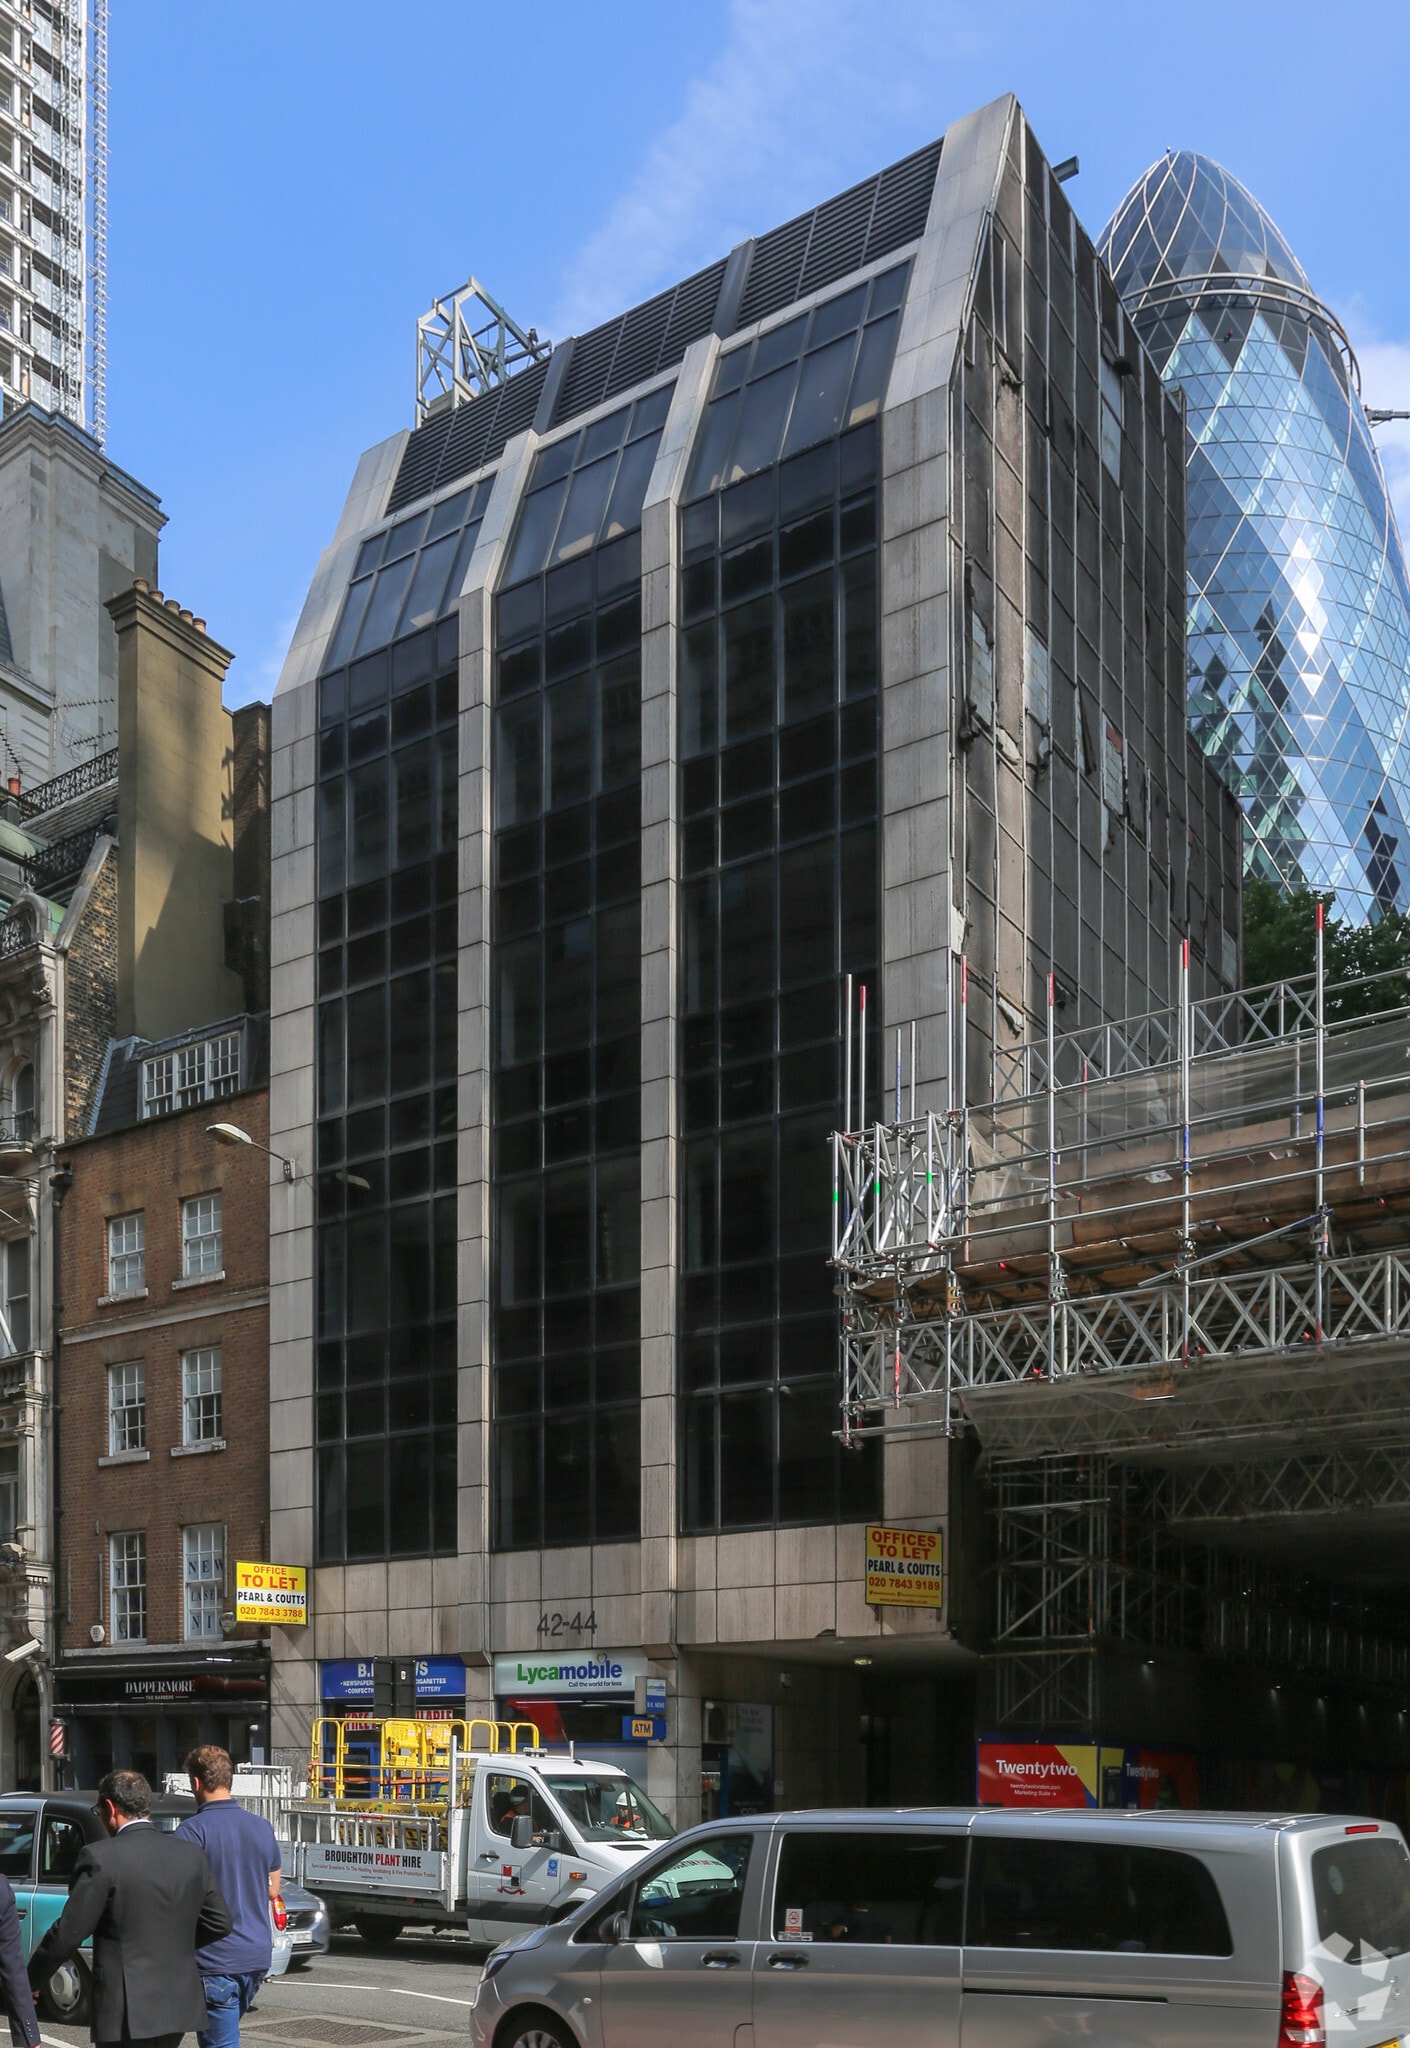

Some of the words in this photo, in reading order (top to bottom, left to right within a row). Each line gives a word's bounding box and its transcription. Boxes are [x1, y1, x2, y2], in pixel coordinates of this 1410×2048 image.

[872, 1530, 937, 1548] OFFICES
[877, 1544, 897, 1557] TO
[902, 1546, 931, 1560] LET
[253, 1565, 287, 1575] OFFICE
[868, 1559, 895, 1573] PEARL
[897, 1562, 905, 1574] &
[907, 1562, 940, 1577] COUTTS
[241, 1574, 264, 1588] TO
[269, 1576, 298, 1590] LET
[869, 1576, 886, 1587] 020
[889, 1578, 913, 1589] 7843
[916, 1580, 940, 1591] 9189
[238, 1591, 264, 1602] PEARL
[266, 1593, 273, 1602] &
[275, 1594, 305, 1605] COUTTS
[240, 1606, 257, 1615] 020
[259, 1607, 281, 1617] 7843
[282, 1609, 303, 1618] 3788
[537, 1610, 598, 1637] 42-44
[517, 1657, 622, 1685] Lycamobile
[125, 1680, 196, 1694] DAPPERMORE
[633, 1723, 651, 1735] ATM
[996, 1760, 1078, 1778] Twentytwo
[1126, 1763, 1160, 1781] Twentytwo
[1014, 1789, 1037, 1797] Marketing
[325, 1850, 374, 1865] BROUGHTON
[375, 1853, 400, 1867] PLANT
[402, 1855, 422, 1868] HIRE
